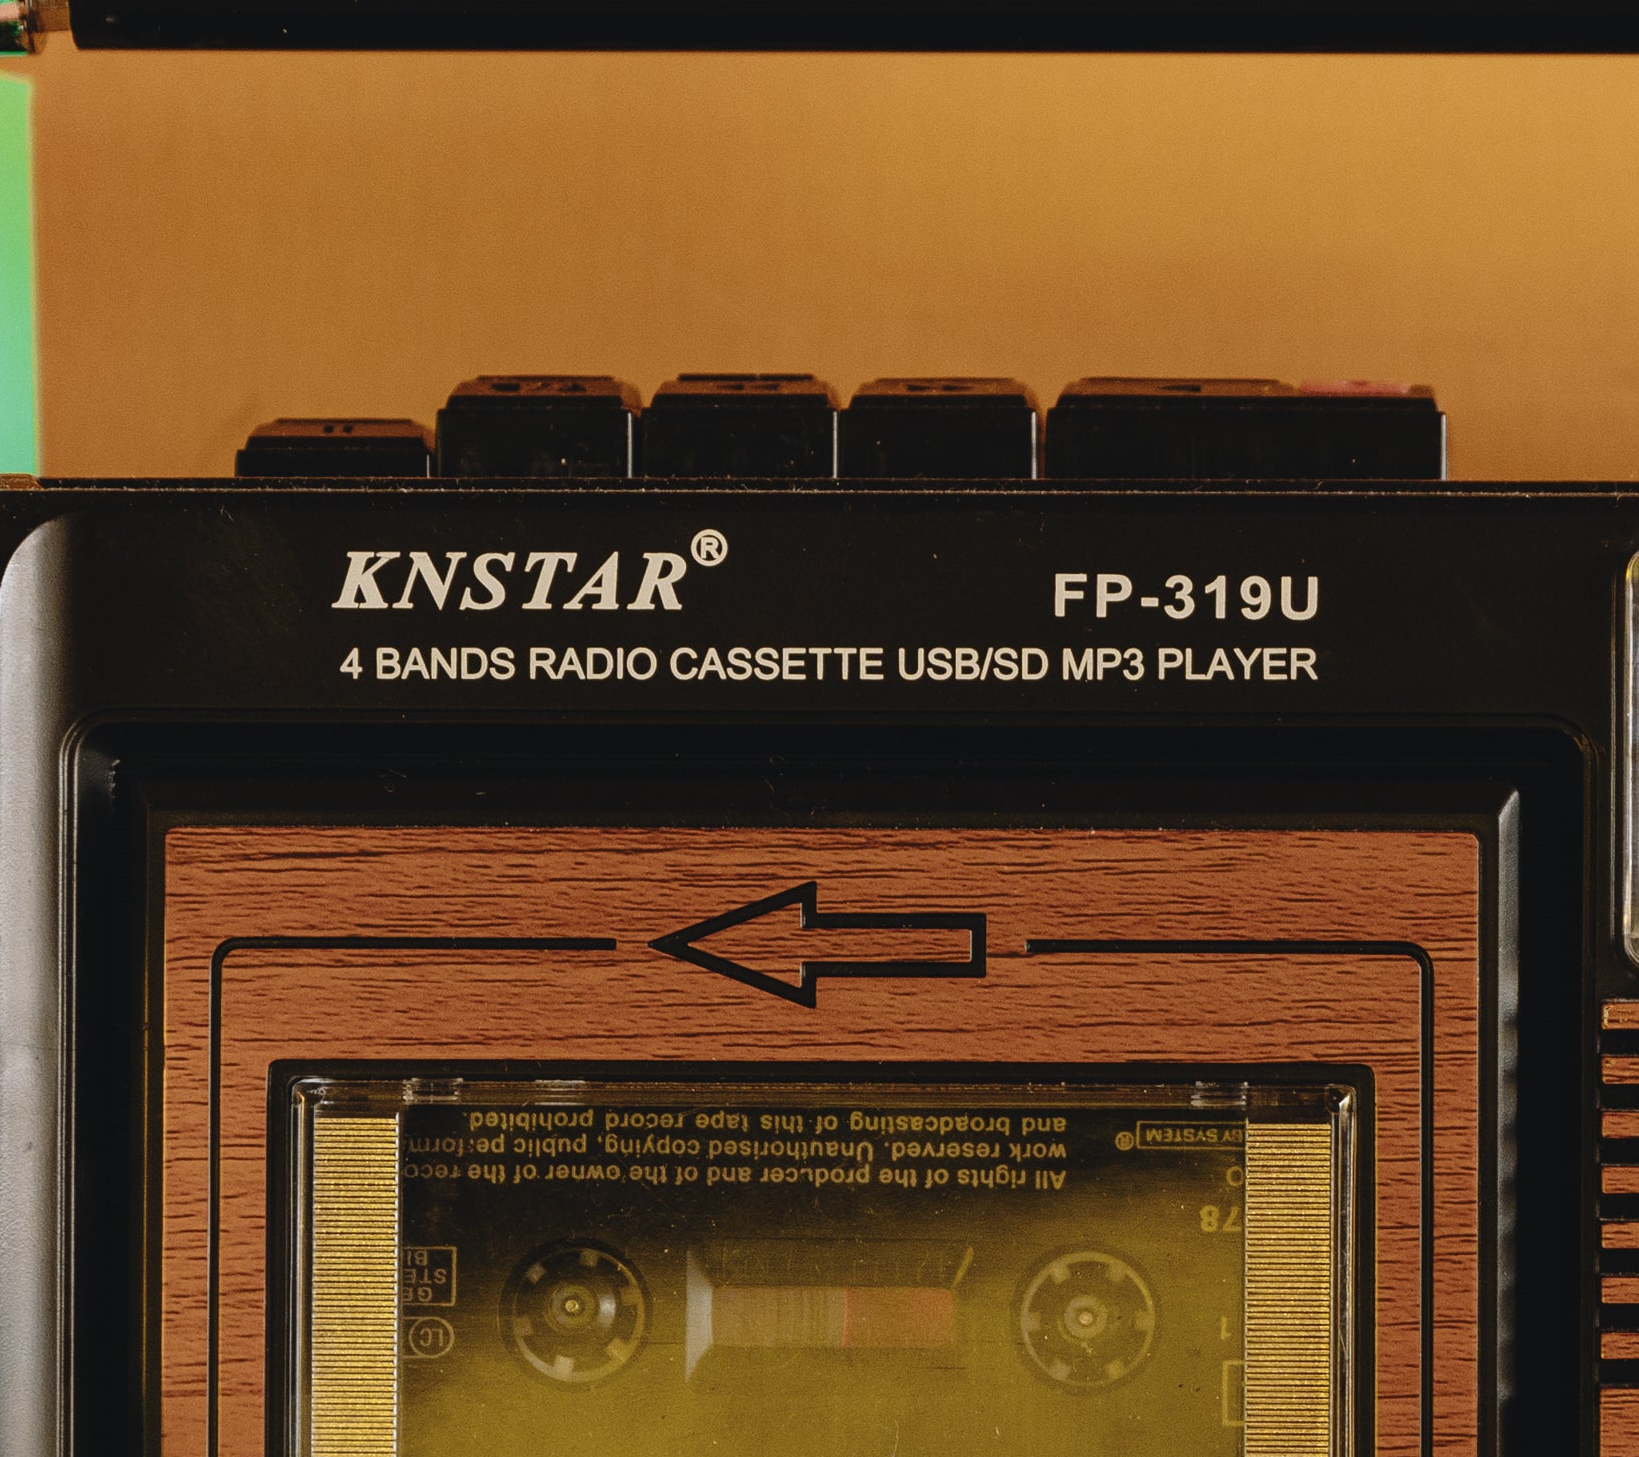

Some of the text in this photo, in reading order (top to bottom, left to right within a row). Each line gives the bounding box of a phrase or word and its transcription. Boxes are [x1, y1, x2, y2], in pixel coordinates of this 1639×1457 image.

[1055, 574, 1318, 620] FP-319U
[340, 647, 1317, 680] 4 BANDS RADIO CASSETTE USB/SD MP3 PLAYER
[605, 1113, 684, 1131] record
[696, 1111, 748, 1132] tape
[760, 1115, 803, 1133] this
[849, 1111, 1010, 1135] broadcasting
[1021, 1118, 1066, 1135] and
[514, 1134, 587, 1157] public
[708, 1140, 873, 1162] Unauthorised
[1008, 1143, 1066, 1162] work
[469, 1164, 505, 1184] the
[544, 1165, 620, 1180] owner
[630, 1165, 666, 1185] the
[706, 1167, 751, 1186] and
[879, 1169, 917, 1187] the
[925, 1169, 949, 1188] of
[956, 1165, 1026, 1188] rights
[1034, 1171, 1066, 1189] All
